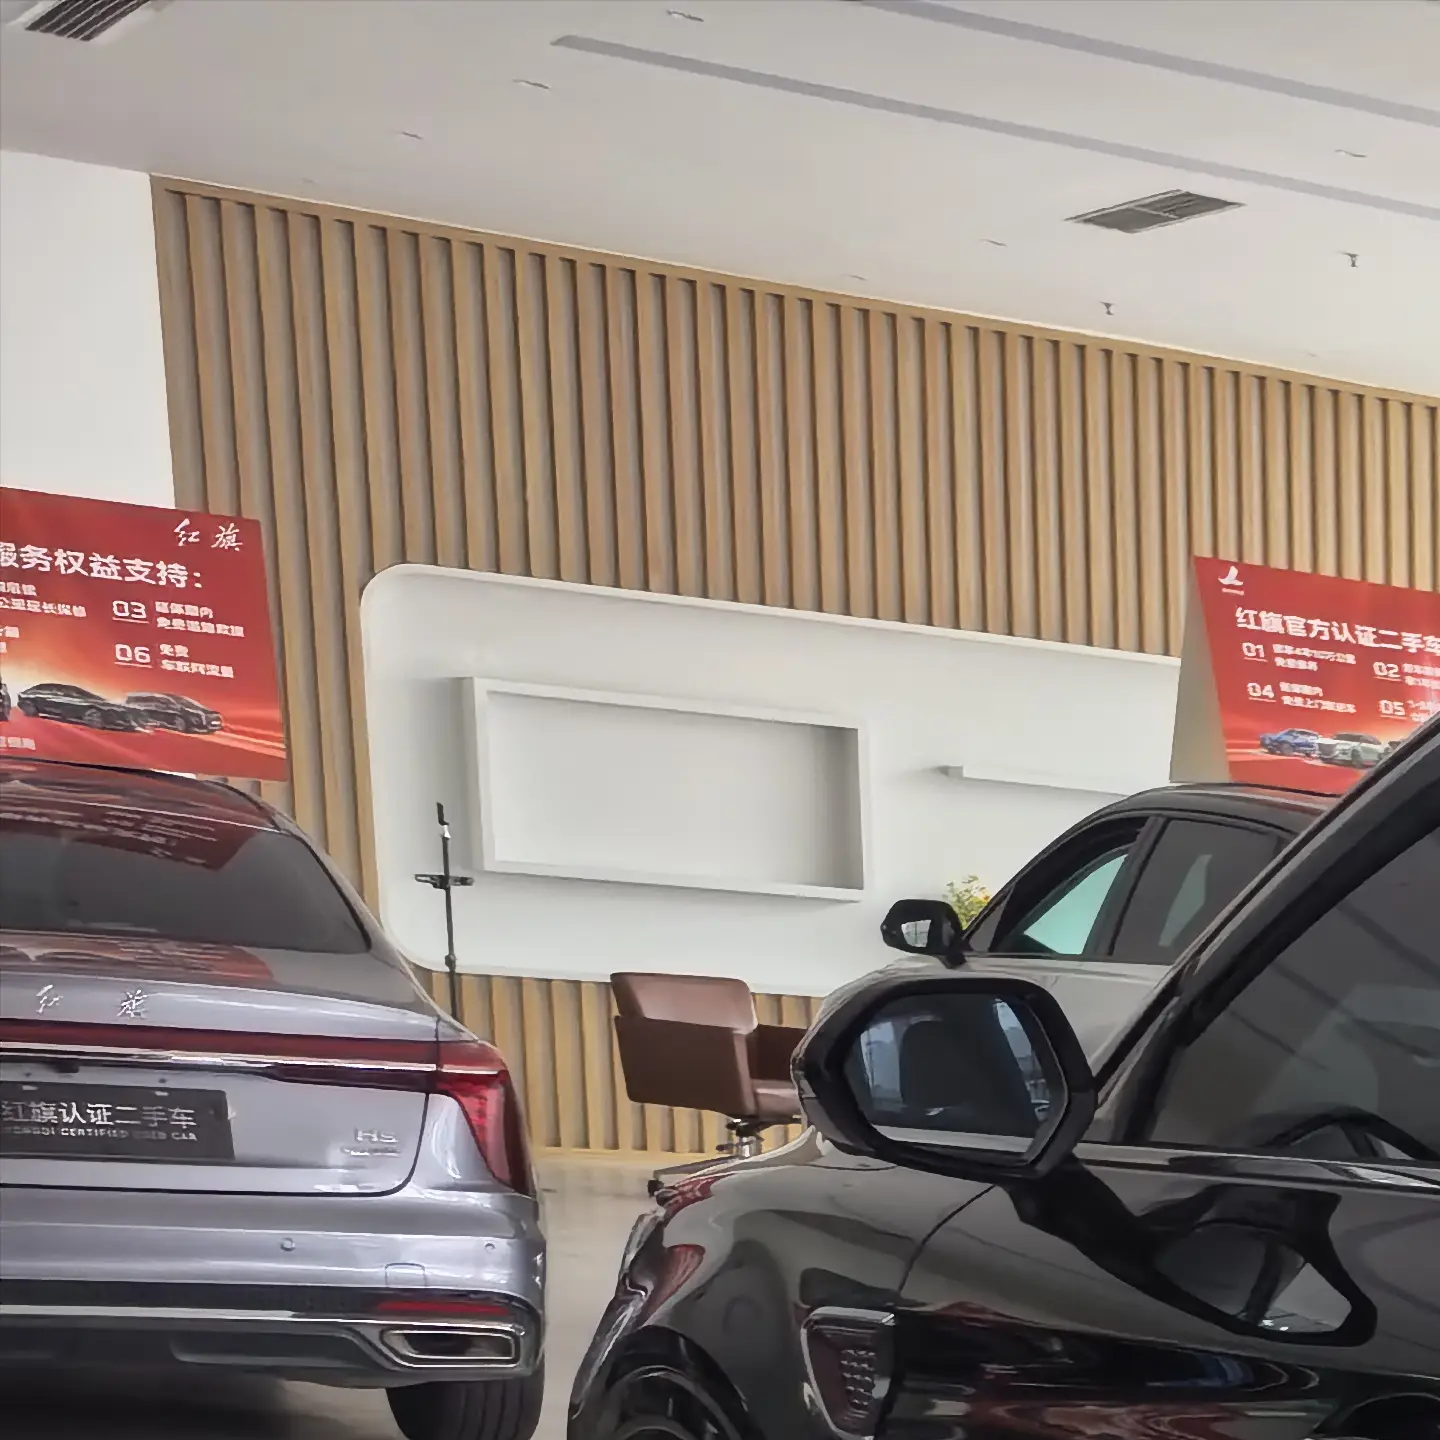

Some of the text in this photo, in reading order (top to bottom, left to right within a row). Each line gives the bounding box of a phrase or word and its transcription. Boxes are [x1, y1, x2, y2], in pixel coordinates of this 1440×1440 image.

[174, 518, 244, 551] 红旗
[112, 600, 147, 619] 03
[115, 644, 150, 663] 06
[1242, 642, 1265, 658] 01
[1373, 661, 1400, 678] 02
[1247, 682, 1275, 699] 04
[1379, 699, 1406, 717] 05
[1, 1100, 197, 1130] 红旗认证二手车
